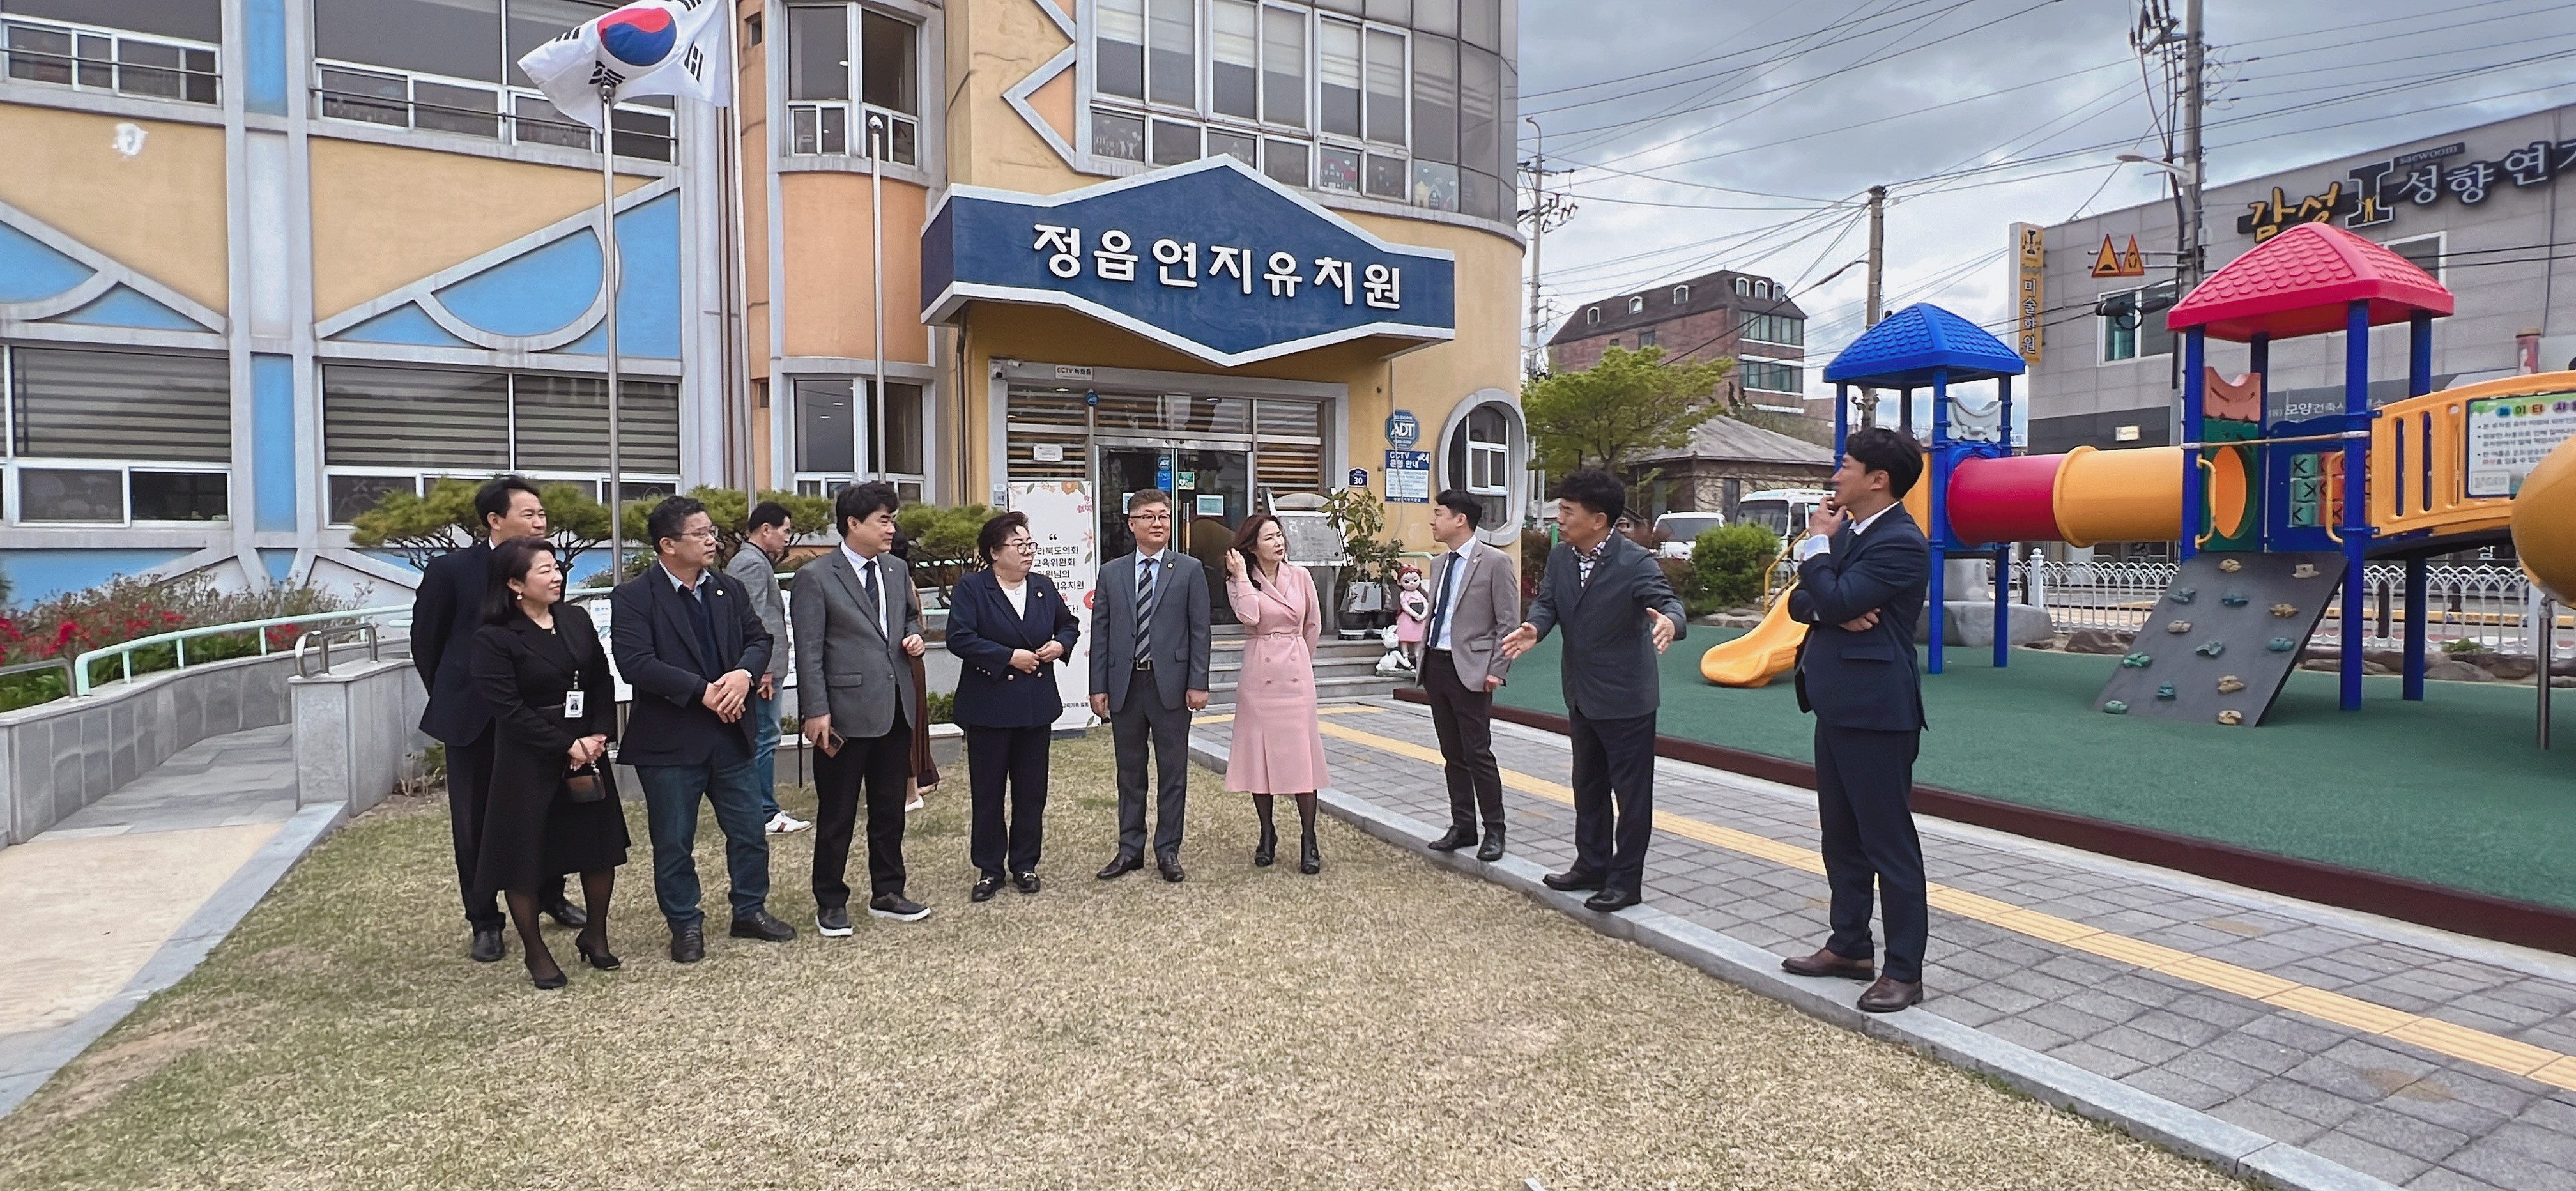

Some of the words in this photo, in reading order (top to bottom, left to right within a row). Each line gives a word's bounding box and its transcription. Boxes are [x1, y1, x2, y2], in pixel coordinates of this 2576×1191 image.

[2248, 181, 2341, 242] 감성
[1033, 224, 1400, 309] 정읍연지유치원
[2022, 279, 2037, 355] 미술학원
[1390, 422, 1415, 436] ADT
[1390, 451, 1410, 459] CCTV
[1390, 459, 1403, 468] 운영
[1405, 460, 1419, 468] 안내
[1034, 546, 1079, 555] 라북도의회
[1034, 558, 1075, 567] 교육위원회
